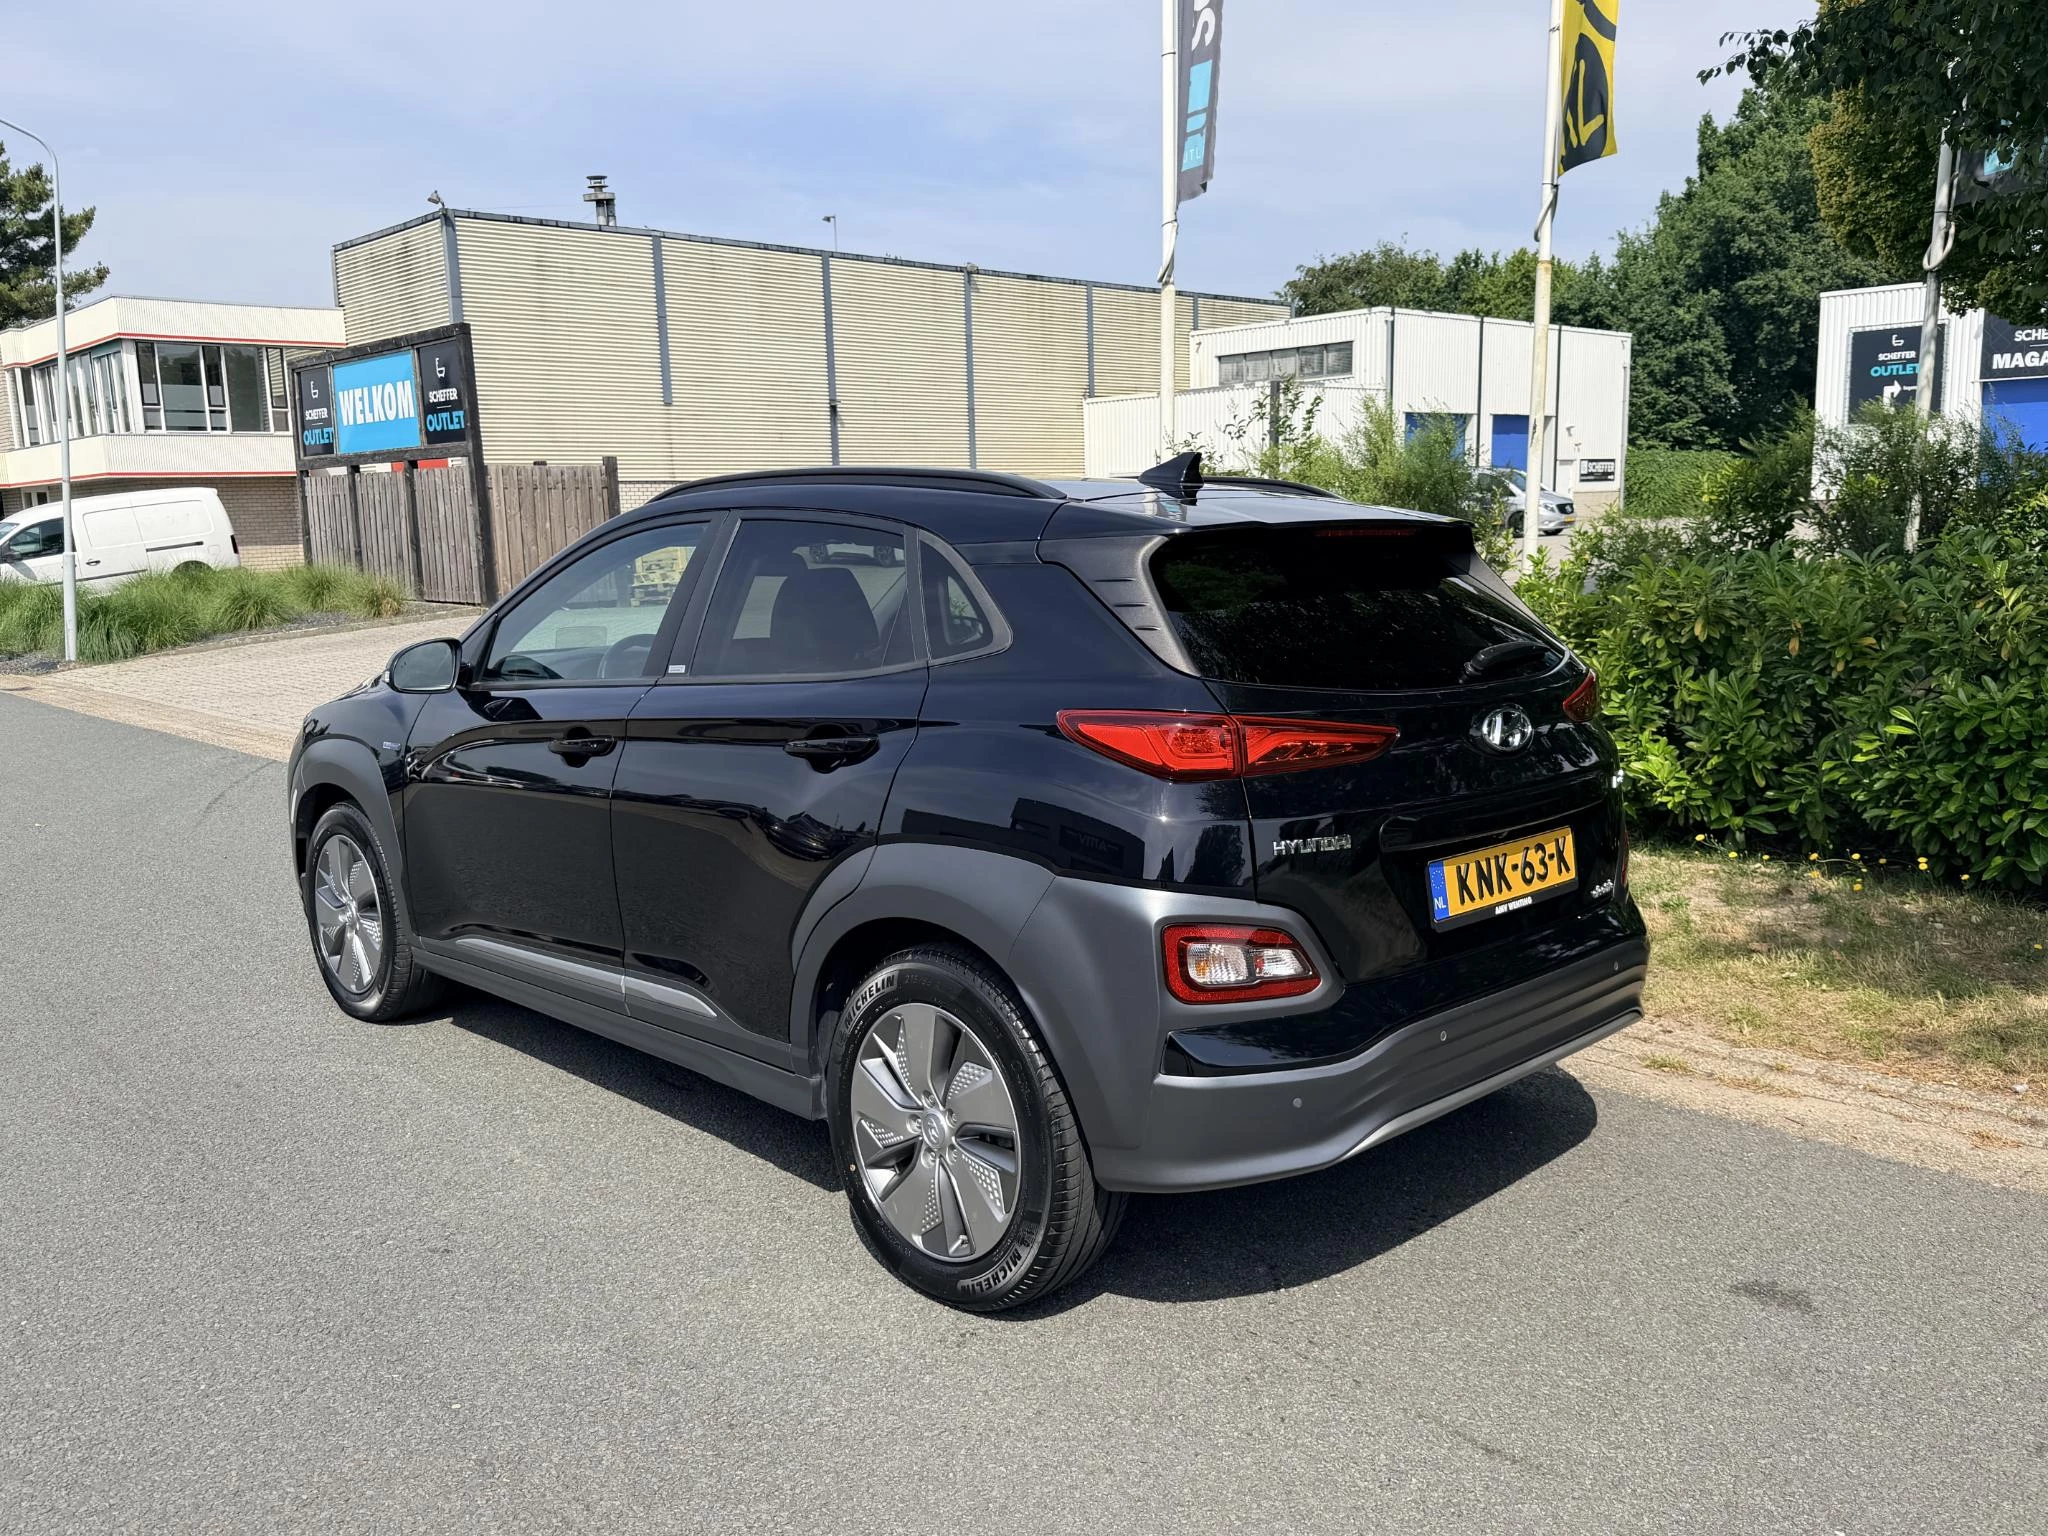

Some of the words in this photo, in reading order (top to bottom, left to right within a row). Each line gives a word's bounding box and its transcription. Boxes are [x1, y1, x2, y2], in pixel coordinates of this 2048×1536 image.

[1878, 350, 1916, 361] SCHEFFER
[339, 379, 415, 427] WELKOM
[429, 387, 458, 403] SCHEFFER
[305, 407, 328, 421] SCHEFFER
[426, 410, 465, 432] OUTLET
[303, 427, 334, 446] OUTLET
[1455, 835, 1571, 907] KNK-63-K
[1433, 896, 1447, 910] NL
[844, 974, 895, 1030] MICHELIN
[960, 1247, 1022, 1295] MICHELIN
